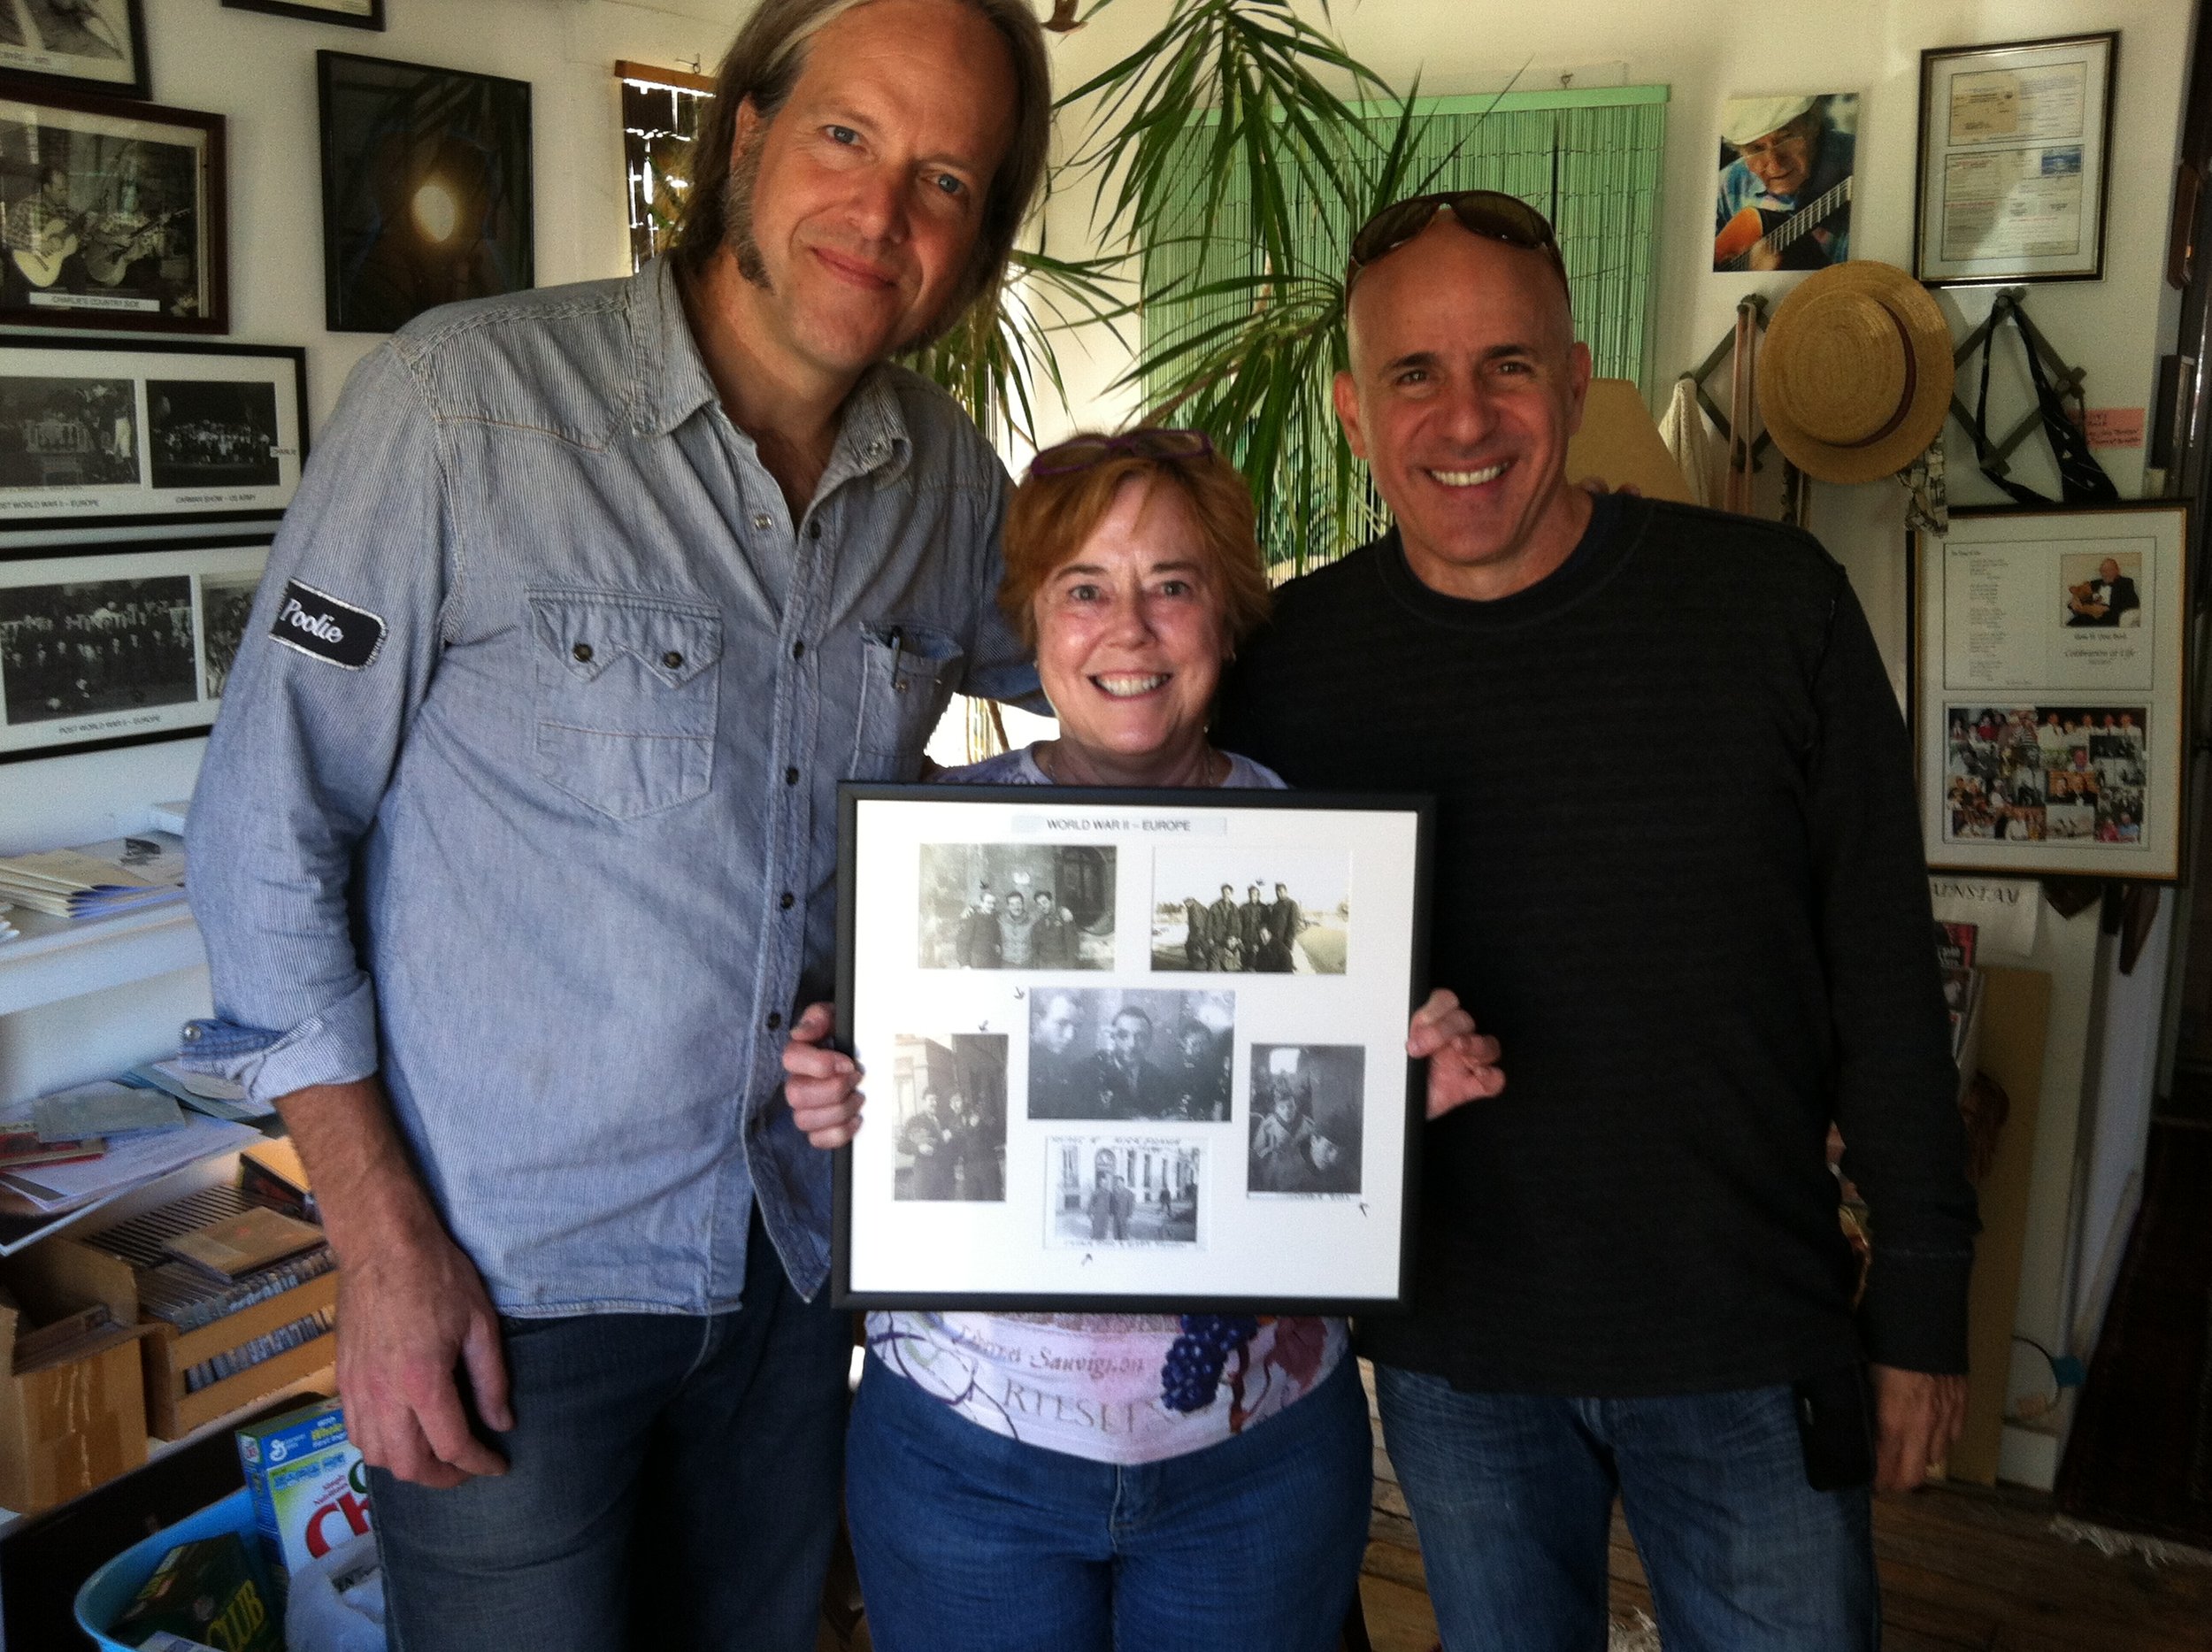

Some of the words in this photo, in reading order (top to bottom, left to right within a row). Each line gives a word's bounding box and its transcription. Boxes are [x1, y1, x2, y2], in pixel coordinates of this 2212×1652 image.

[90, 297, 122, 307] COUNTRY
[280, 598, 344, 643] Poolie
[79, 722, 105, 731] WORLD
[132, 714, 160, 725] EUROPE
[1047, 818, 1091, 831] WORLD
[1093, 818, 1120, 831] WAR
[1142, 819, 1191, 832] EUROPE
